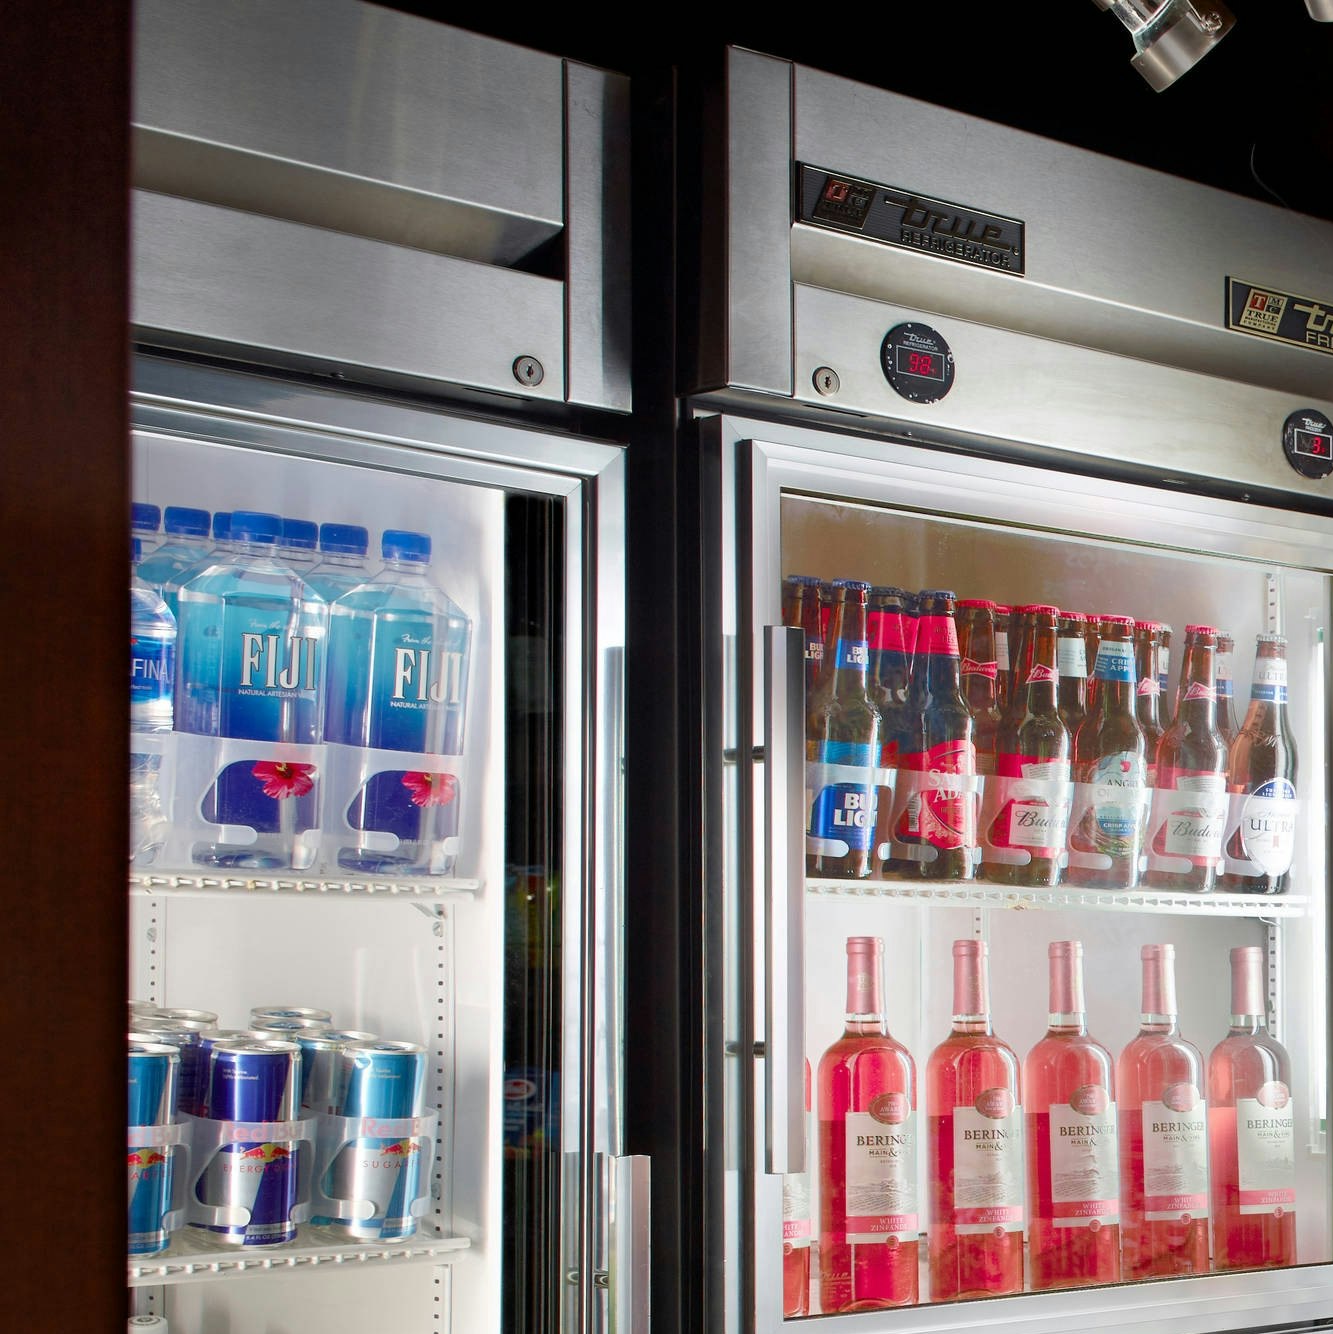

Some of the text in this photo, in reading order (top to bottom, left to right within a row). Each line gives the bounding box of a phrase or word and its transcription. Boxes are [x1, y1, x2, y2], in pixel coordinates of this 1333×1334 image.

[902, 229, 1011, 268] REFRIGERATOR
[1246, 309, 1278, 323] TRUE
[240, 632, 317, 691] FIJI
[393, 647, 464, 703] FIJI
[390, 701, 417, 709] NATURAL
